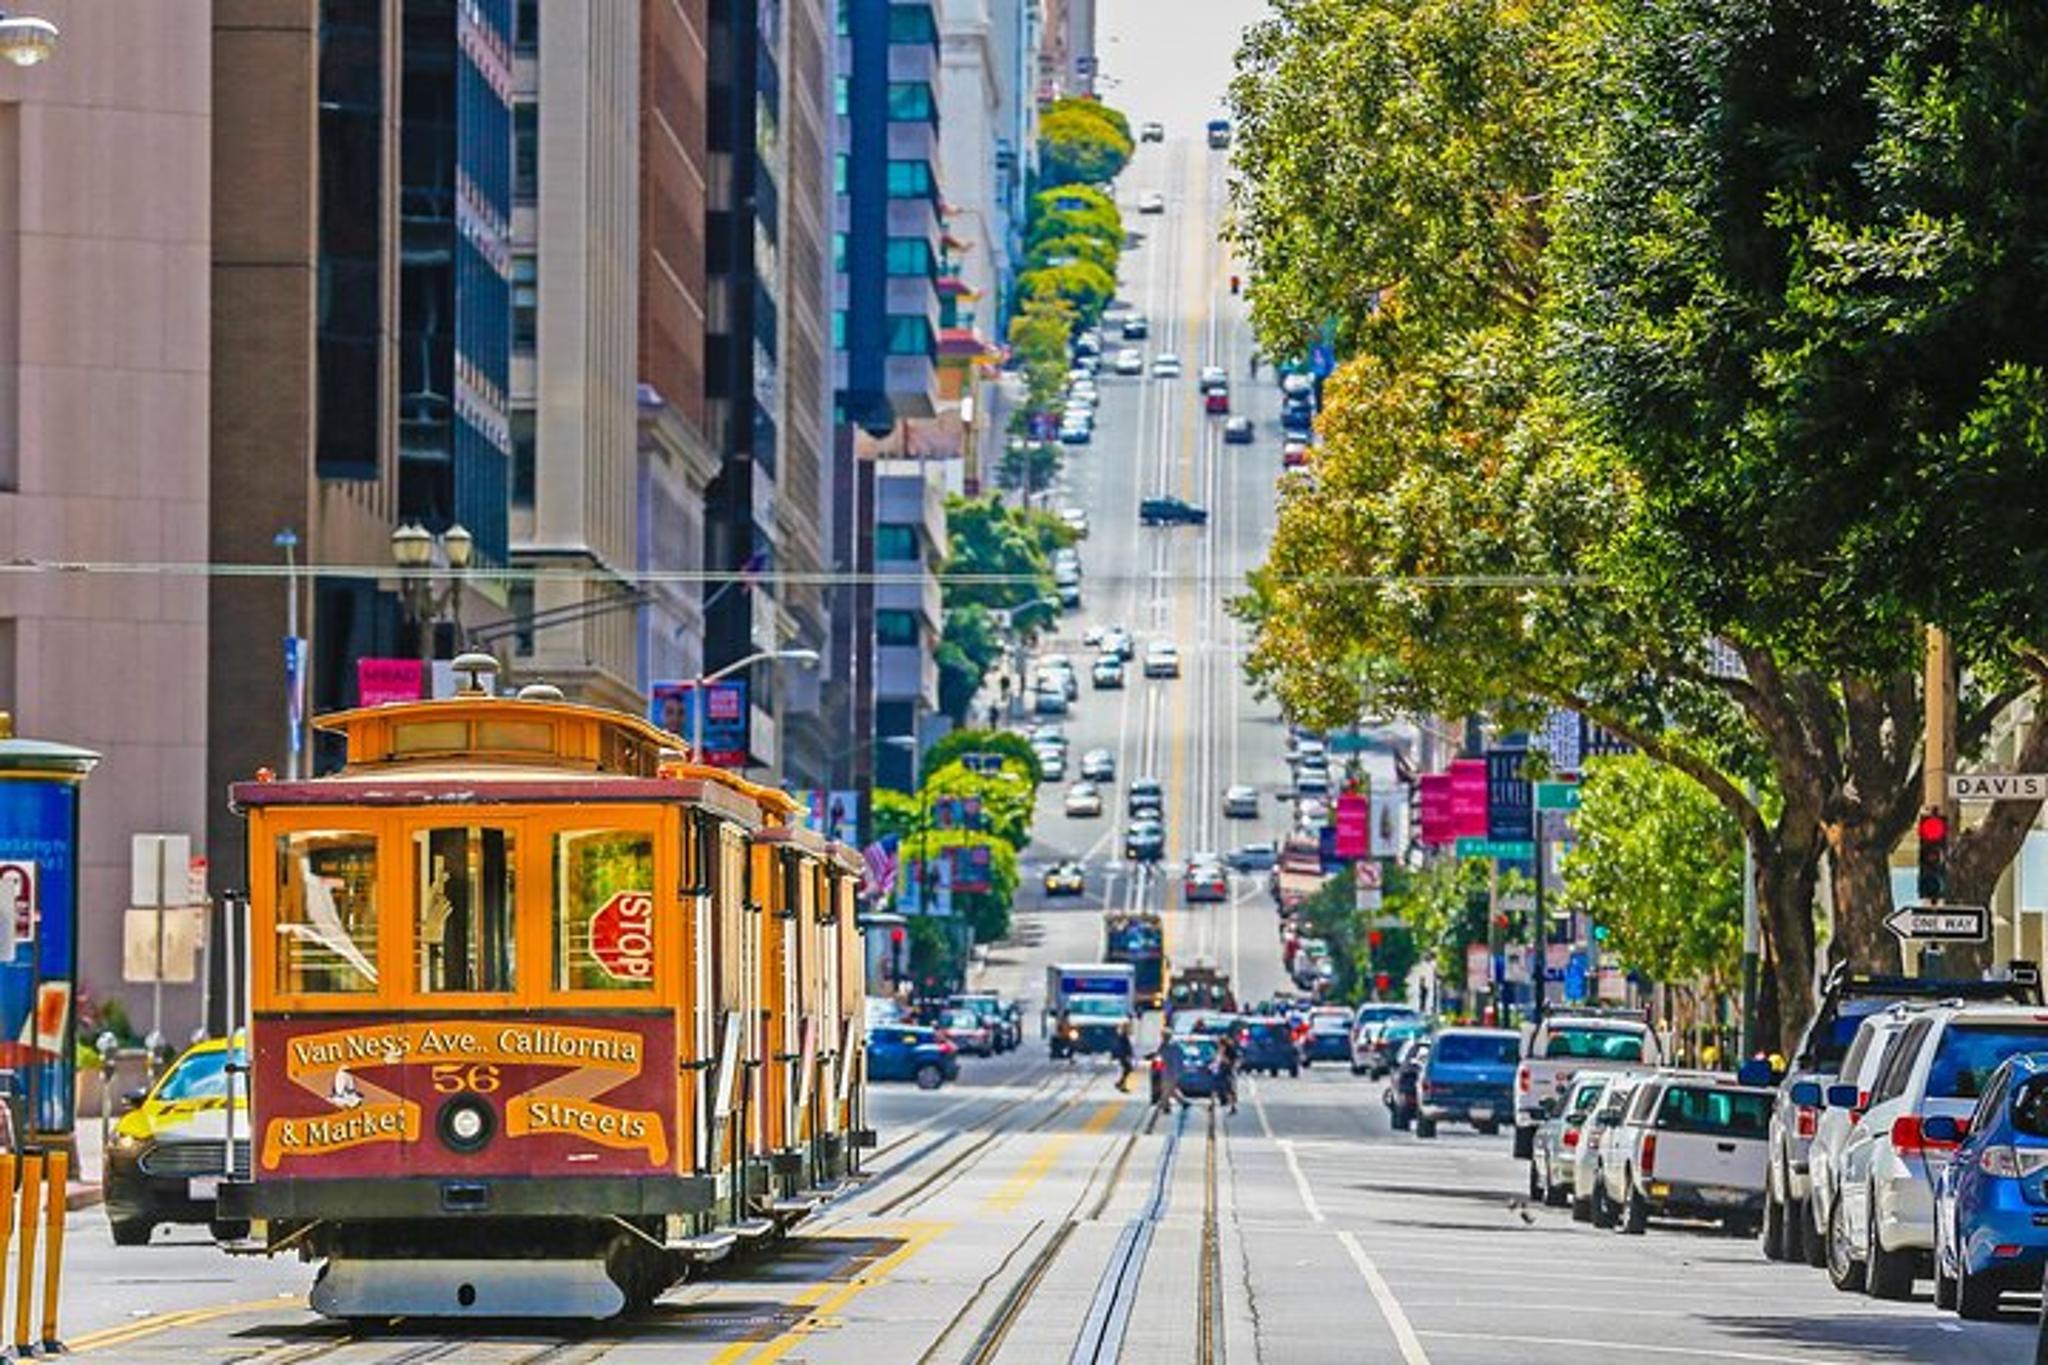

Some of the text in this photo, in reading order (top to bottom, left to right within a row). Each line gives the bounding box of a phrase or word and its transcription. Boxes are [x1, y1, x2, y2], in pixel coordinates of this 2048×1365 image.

[1956, 778, 2038, 794] DAVIS
[618, 897, 652, 975] STOP
[1911, 916, 1975, 930] ONE WAY
[295, 1042, 342, 1066] Van
[344, 1034, 411, 1059] Ness
[498, 1028, 636, 1061] California
[432, 1064, 499, 1093] 56
[282, 1108, 406, 1146] & Market
[529, 1102, 647, 1138] Streets
